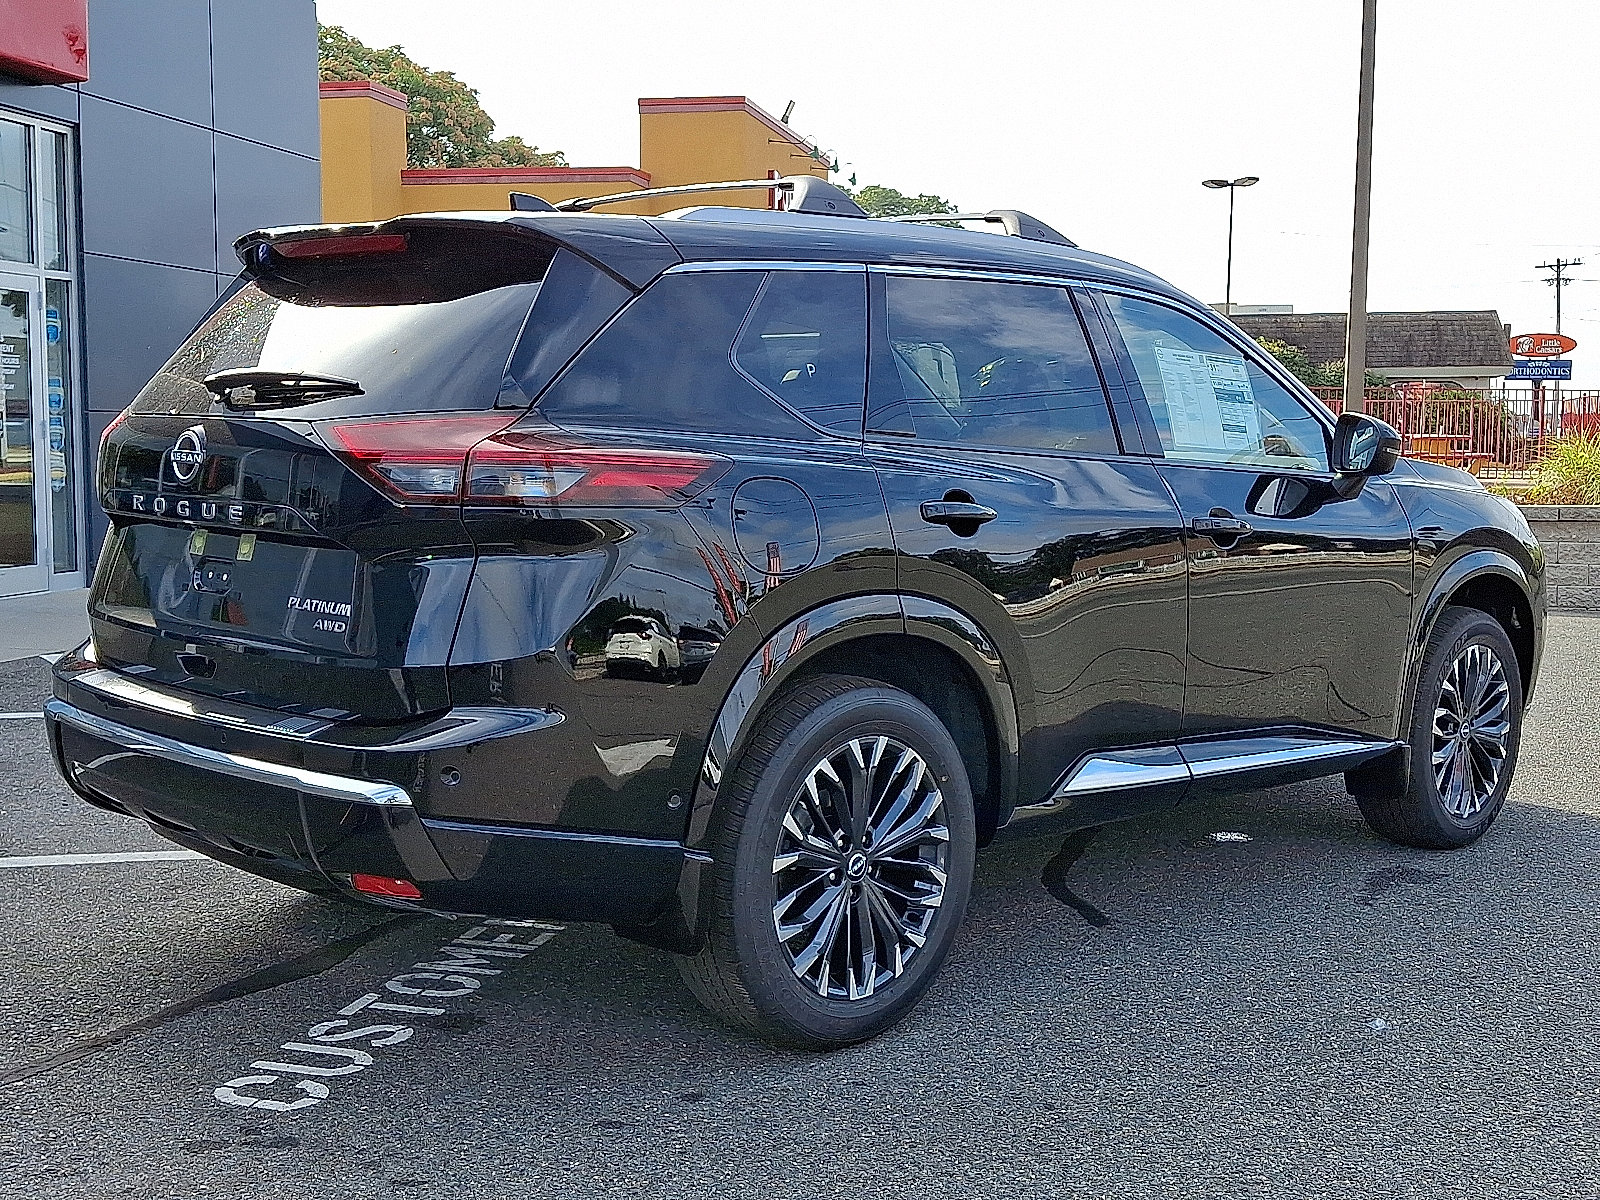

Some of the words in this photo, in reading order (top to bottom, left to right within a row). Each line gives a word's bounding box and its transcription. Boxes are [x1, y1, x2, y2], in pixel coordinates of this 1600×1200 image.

[132, 494, 243, 521] ROGUE
[287, 596, 351, 617] PLATINUM
[313, 619, 346, 632] AWD
